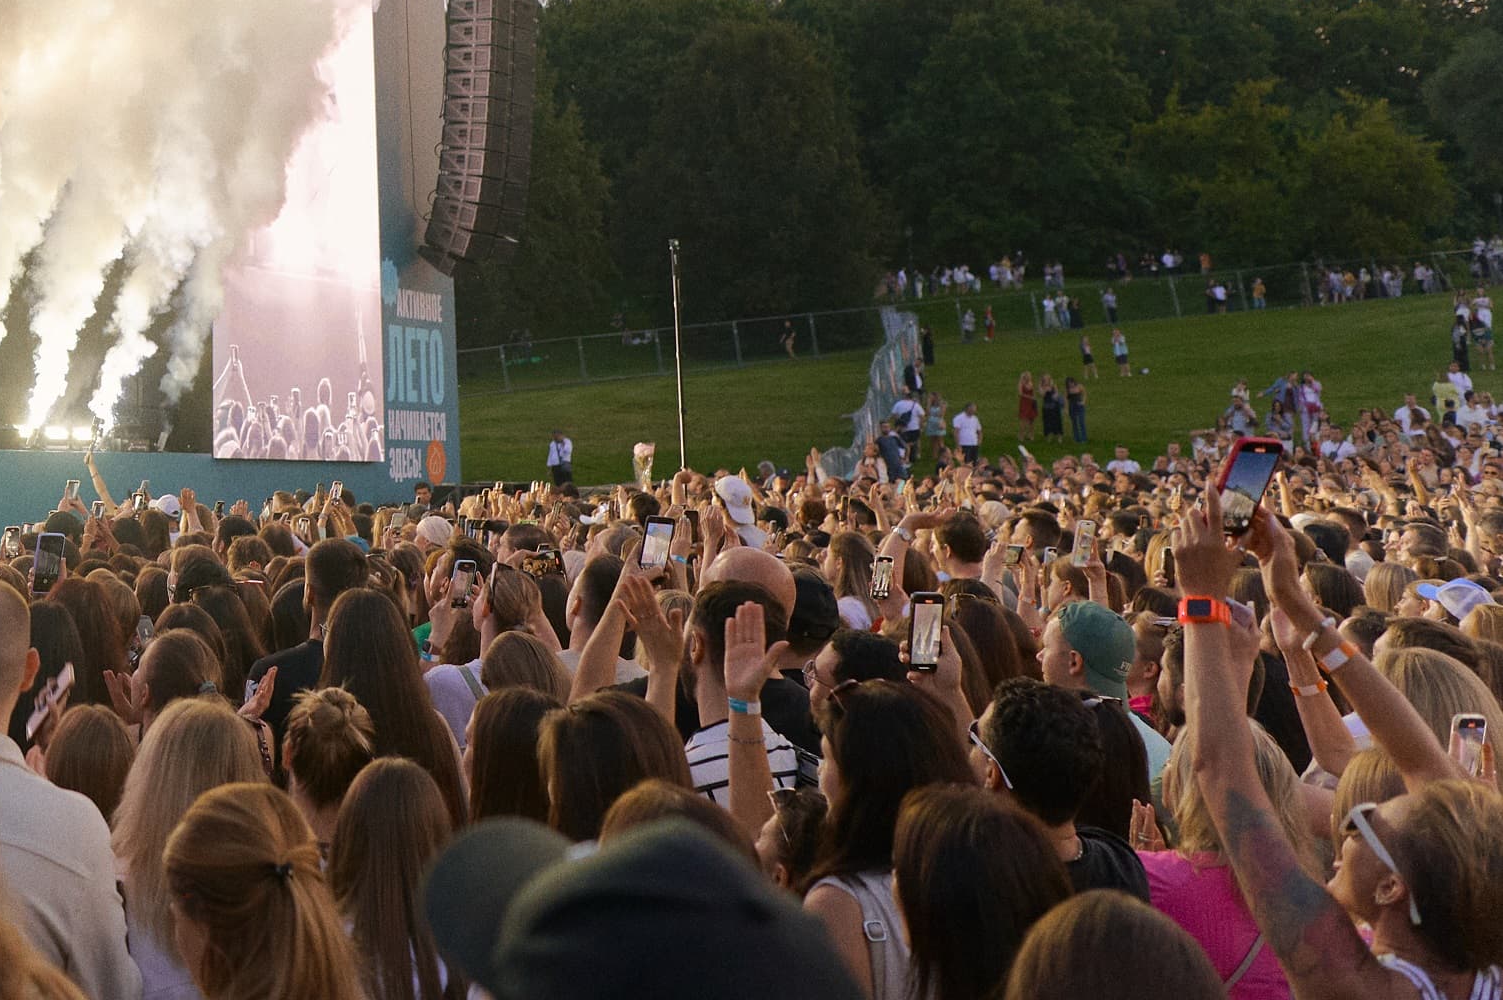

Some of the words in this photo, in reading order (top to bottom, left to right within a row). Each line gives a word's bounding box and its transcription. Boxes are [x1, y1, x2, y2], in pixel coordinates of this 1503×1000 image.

[396, 289, 442, 322] АКТИВНОЕ
[388, 324, 445, 405] ЛЕТО
[388, 409, 446, 441] НАЧИНАЕТСЯ
[390, 447, 422, 482] ЗДЕСЬ!
